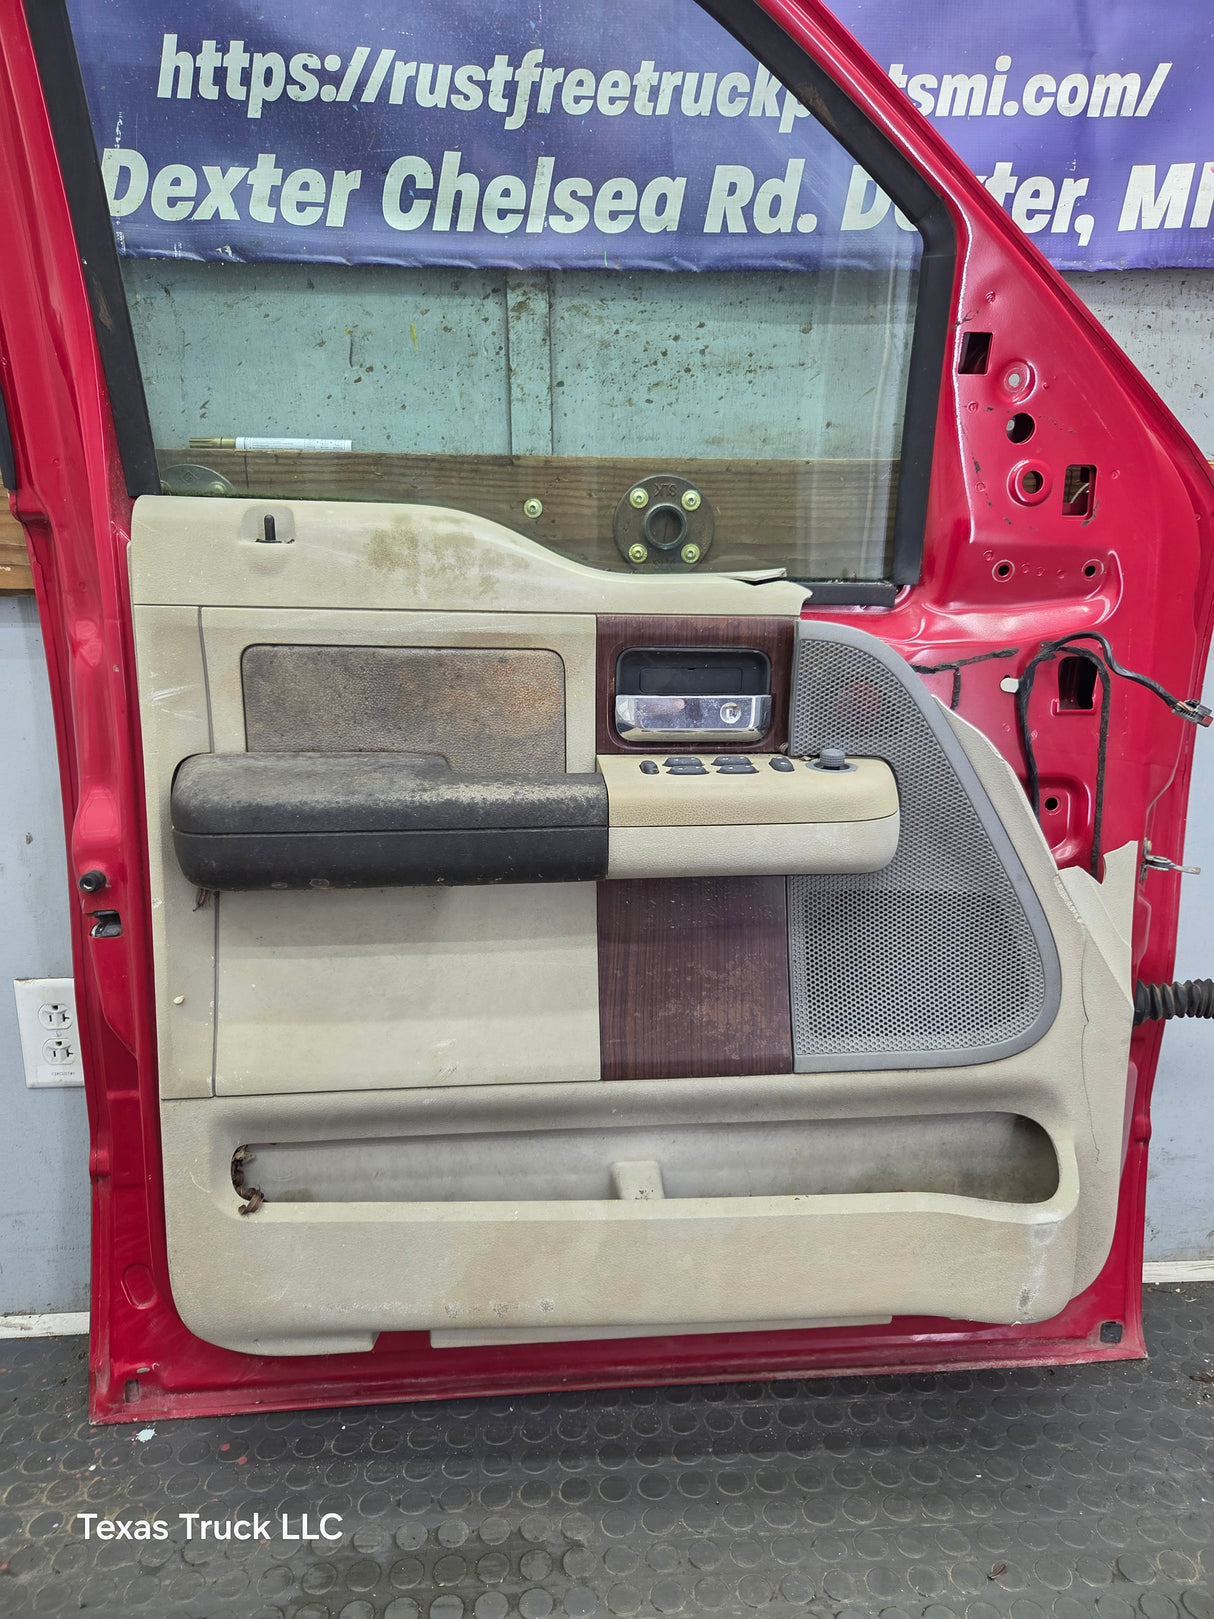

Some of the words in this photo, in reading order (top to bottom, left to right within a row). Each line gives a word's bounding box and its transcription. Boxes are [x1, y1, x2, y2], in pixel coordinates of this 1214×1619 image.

[156, 33, 1173, 133] https://rustfreetruckpsmi.com/
[101, 148, 362, 228] Dexter
[381, 151, 687, 234] Chelsea
[703, 158, 818, 234] Rd.
[840, 162, 1095, 247] Dter,
